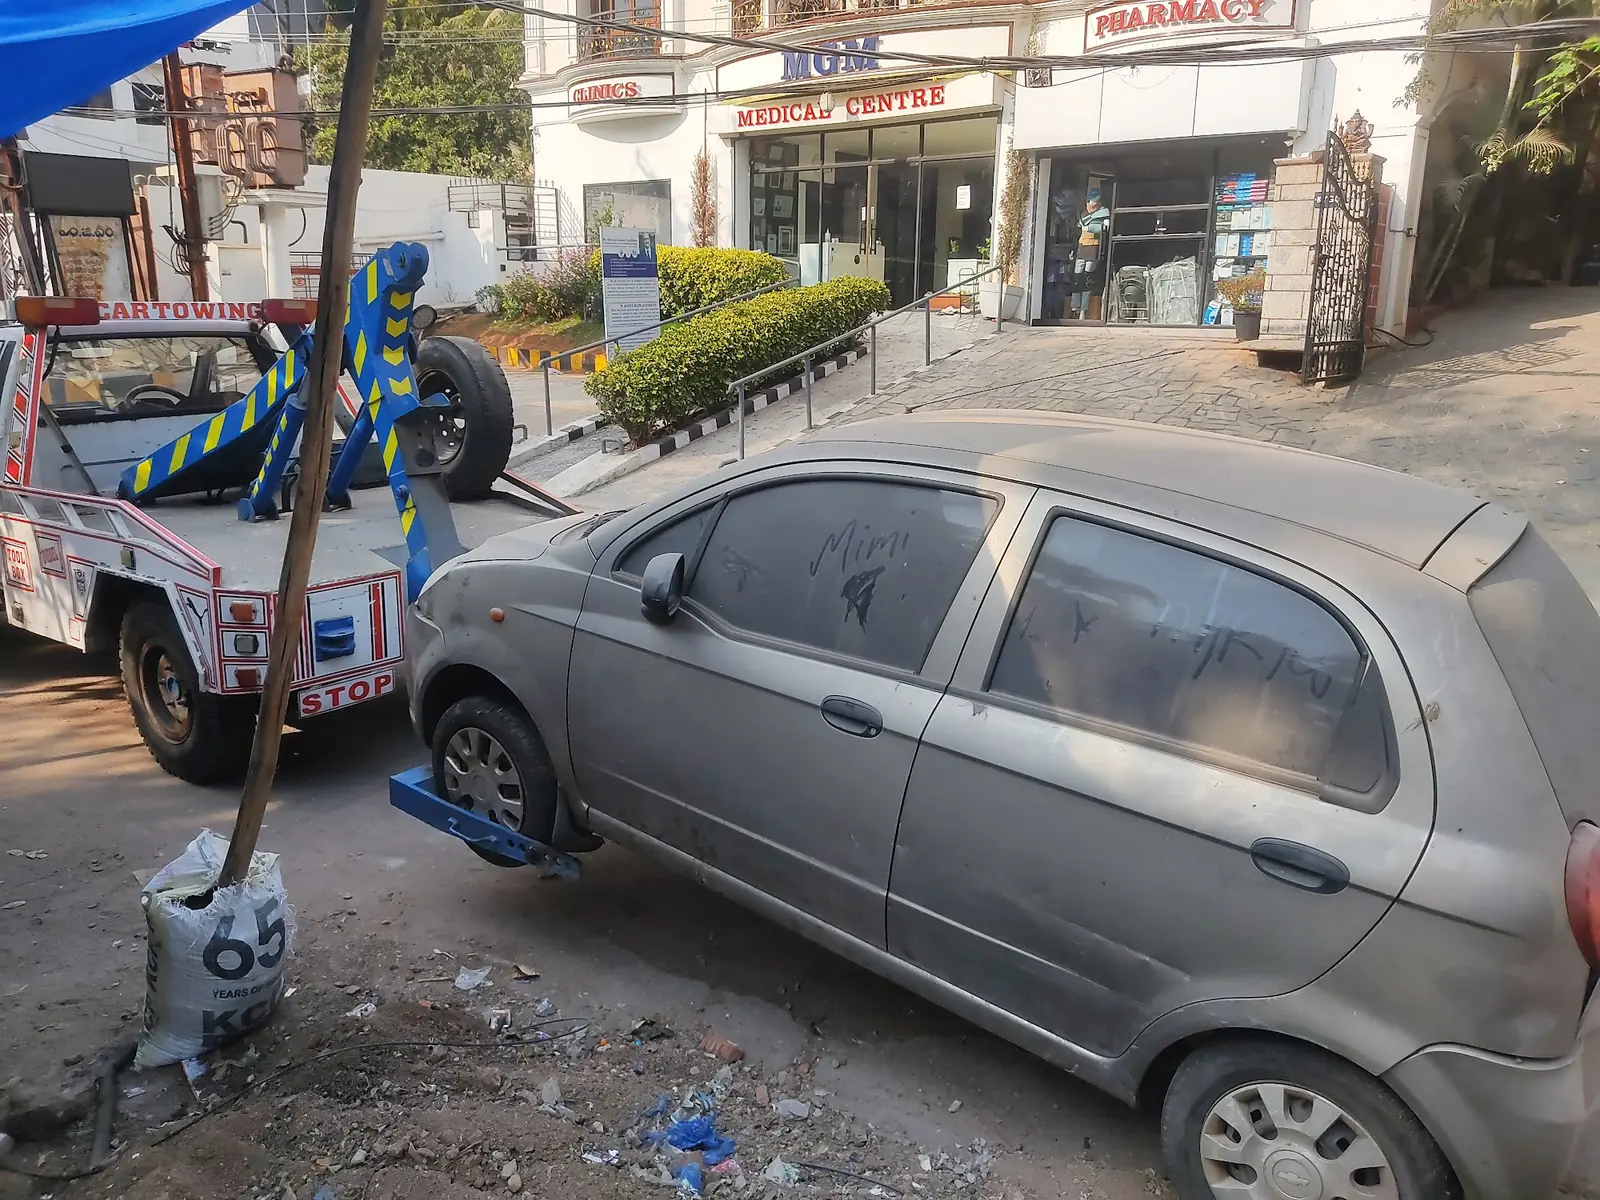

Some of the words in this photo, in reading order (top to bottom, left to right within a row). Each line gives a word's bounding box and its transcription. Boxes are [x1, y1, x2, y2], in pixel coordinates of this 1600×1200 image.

[1095, 0, 1265, 36] PHARMACY
[781, 36, 883, 80] MGM
[573, 82, 638, 103] CLINICS
[737, 101, 832, 127] MEDICAL
[846, 85, 945, 116] CENTRE
[98, 303, 150, 319] CAR
[153, 303, 262, 319] TOWING
[7, 547, 26, 564] TOOL
[11, 565, 26, 581] BOX
[302, 674, 392, 714] STOP
[203, 897, 286, 980] 65
[212, 988, 248, 999] YEARS
